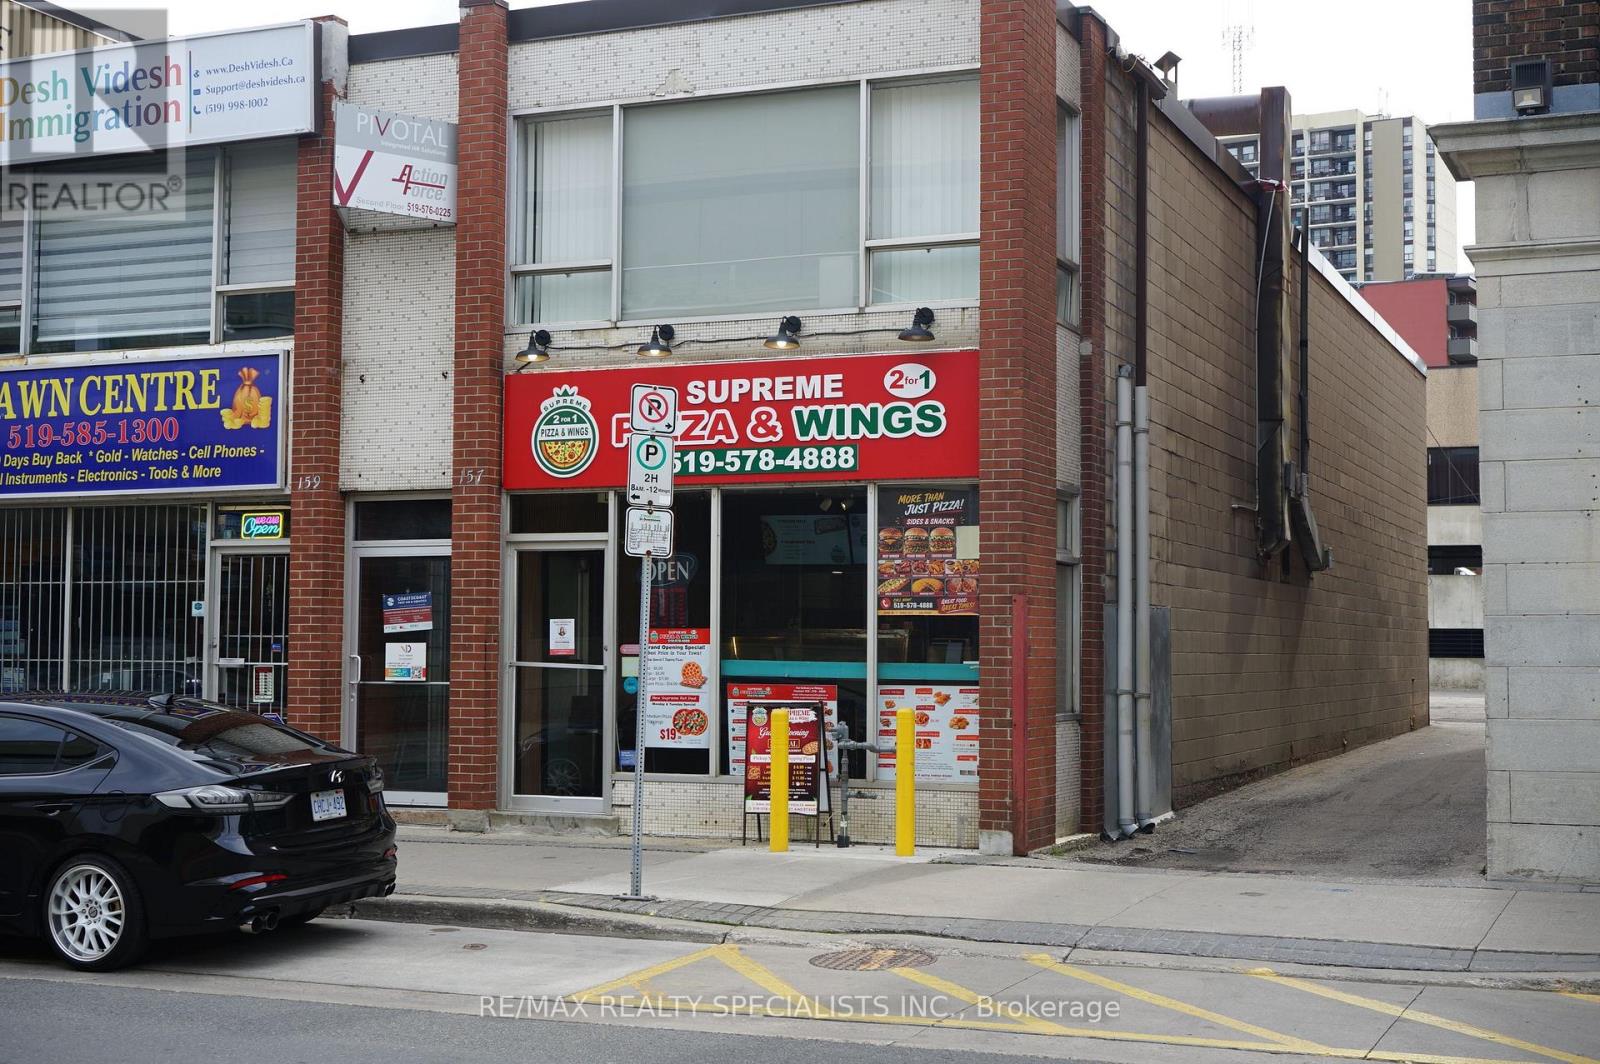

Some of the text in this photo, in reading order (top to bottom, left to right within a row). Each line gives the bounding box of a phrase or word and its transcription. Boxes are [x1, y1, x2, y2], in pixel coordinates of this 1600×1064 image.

[205, 56, 293, 76] www.DeshVidesh.Ca
[0, 55, 182, 108] Desh Videsh
[205, 74, 306, 96] Support@deshvidesh.ca
[205, 97, 269, 115] (519) 998-1002
[0, 95, 182, 143] Immigration
[356, 112, 449, 149] PIVOTAL
[399, 164, 448, 186] Action
[407, 202, 452, 218] 519-576-0225
[79, 368, 221, 417] CENTRE
[686, 373, 844, 404] SUPREME
[543, 398, 588, 412] SUPREME
[7, 416, 180, 449] 519-585-1300
[540, 428, 559, 438] PIZZA
[567, 427, 589, 436] WINGS
[746, 406, 784, 443] &
[790, 400, 947, 441] WINGS
[3, 454, 30, 470] Days
[31, 453, 54, 468] Buy
[56, 451, 82, 465] Back
[131, 448, 179, 462] Watches
[188, 445, 211, 459] Cell
[213, 444, 257, 458] Phones
[5, 471, 68, 486] Instruments
[77, 467, 138, 483] Electronics
[148, 466, 178, 480] Tools
[181, 465, 190, 479] &
[193, 464, 222, 479] More
[297, 474, 321, 490] 159
[644, 473, 658, 483] 2H
[897, 491, 945, 505] MORE THAN
[904, 498, 965, 516] JUST PIZZA!
[244, 517, 280, 539] Open
